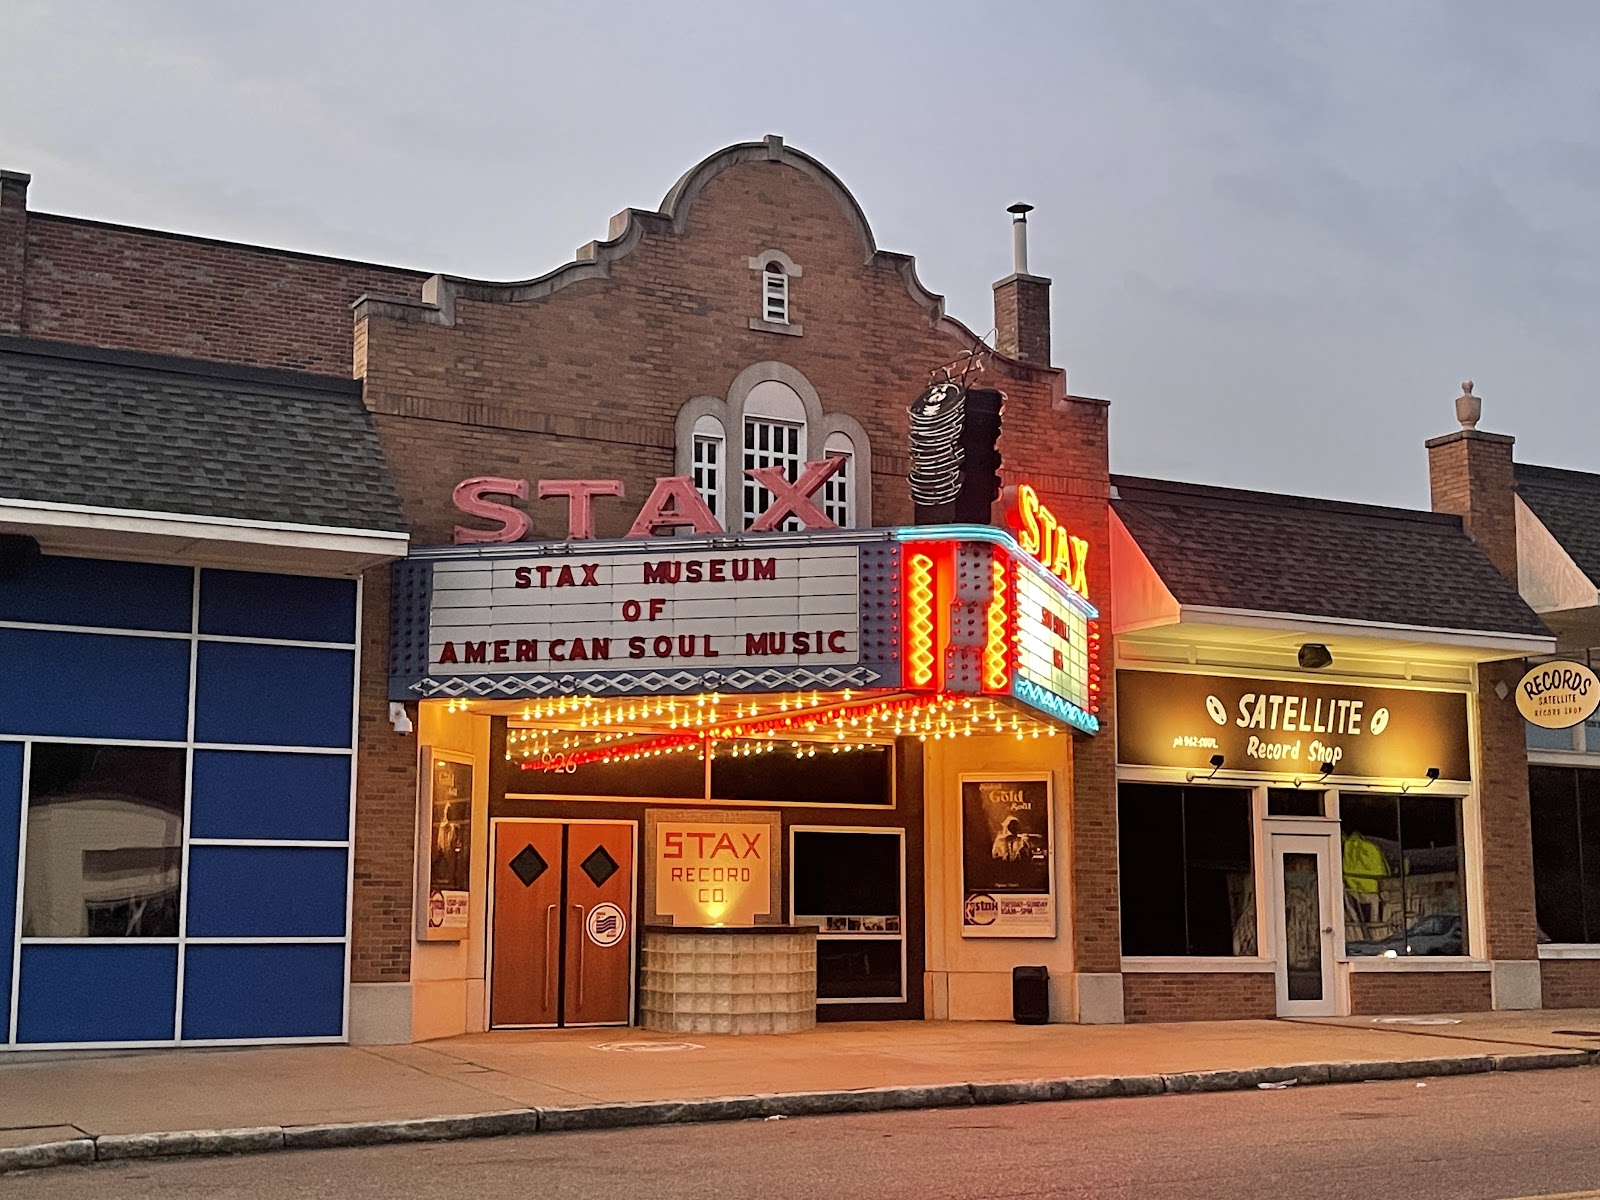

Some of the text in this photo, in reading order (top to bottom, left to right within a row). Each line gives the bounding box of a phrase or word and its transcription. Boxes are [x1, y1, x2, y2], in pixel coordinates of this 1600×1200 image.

[453, 455, 847, 545] STAX
[1018, 484, 1089, 600] STAX
[514, 557, 776, 588] STAX MUSEUM
[622, 598, 666, 622] OF
[438, 630, 847, 664] AMERICAN SOUL MUSIC
[1523, 669, 1592, 701] RECORDS
[1236, 693, 1364, 735] SATELLITE
[1534, 707, 1561, 717] RECORD
[1538, 694, 1577, 706] SATELLITE
[541, 752, 577, 774] 926
[1246, 735, 1343, 767] Record Shop
[663, 832, 761, 859] STAX
[671, 867, 750, 882] RECORD
[698, 888, 728, 903] CO.
